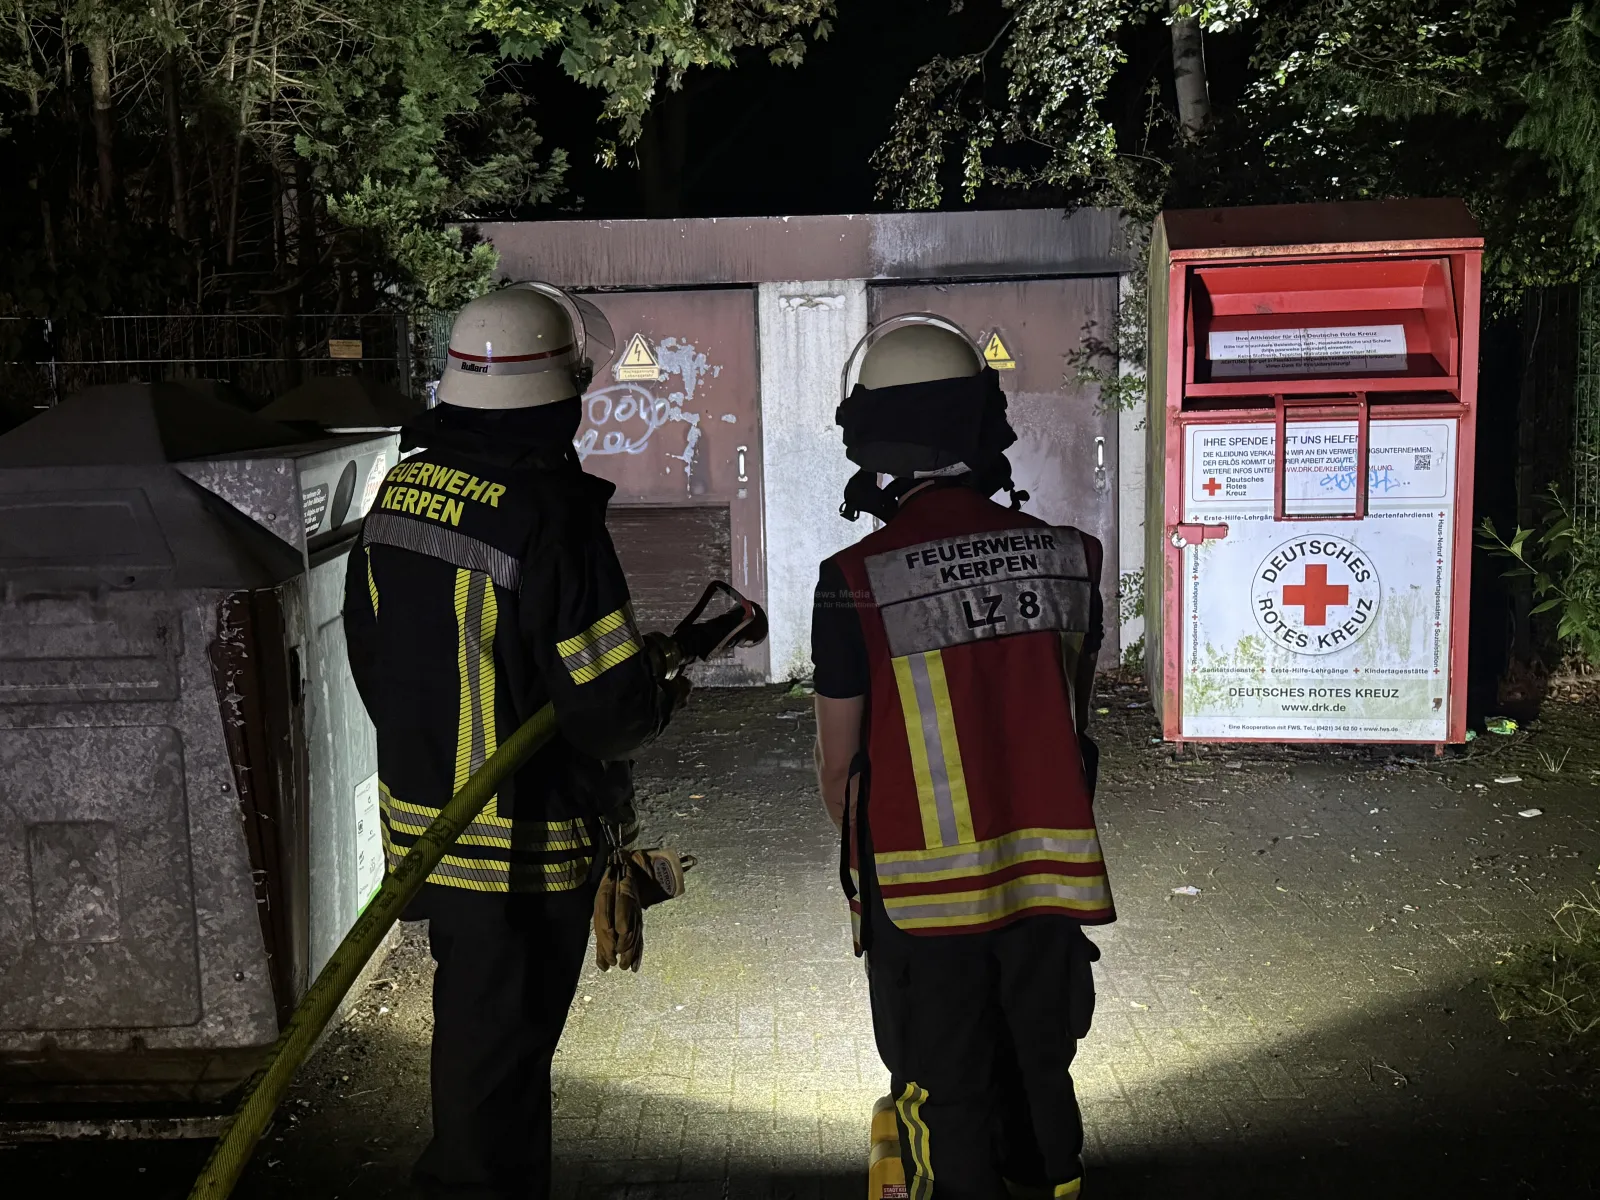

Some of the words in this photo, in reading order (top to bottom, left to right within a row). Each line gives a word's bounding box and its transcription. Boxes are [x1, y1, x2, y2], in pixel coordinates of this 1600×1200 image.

[461, 362, 488, 373] Bullard
[1203, 437, 1226, 446] IHRE
[1228, 436, 1268, 446] SPENDE
[1300, 435, 1322, 444] UNS
[1219, 458, 1240, 466] ERLÖS
[387, 462, 507, 508] EUERWEHR
[381, 486, 464, 527] KERPEN
[905, 534, 1056, 569] FEUERWEHR
[1261, 540, 1371, 584] DEUTSCHES
[941, 554, 1038, 583] KERPEN
[962, 594, 1007, 629] LZ
[1019, 591, 1042, 620] 8
[1258, 598, 1309, 648] ROTES
[1317, 598, 1373, 649] KREUZ
[1364, 667, 1429, 675] Kindertagesstätte
[1228, 687, 1305, 698] DEUTSCHES
[1308, 688, 1351, 698] ROTES
[1355, 688, 1400, 698] KREUZ
[1281, 703, 1346, 712] www.drk.de
